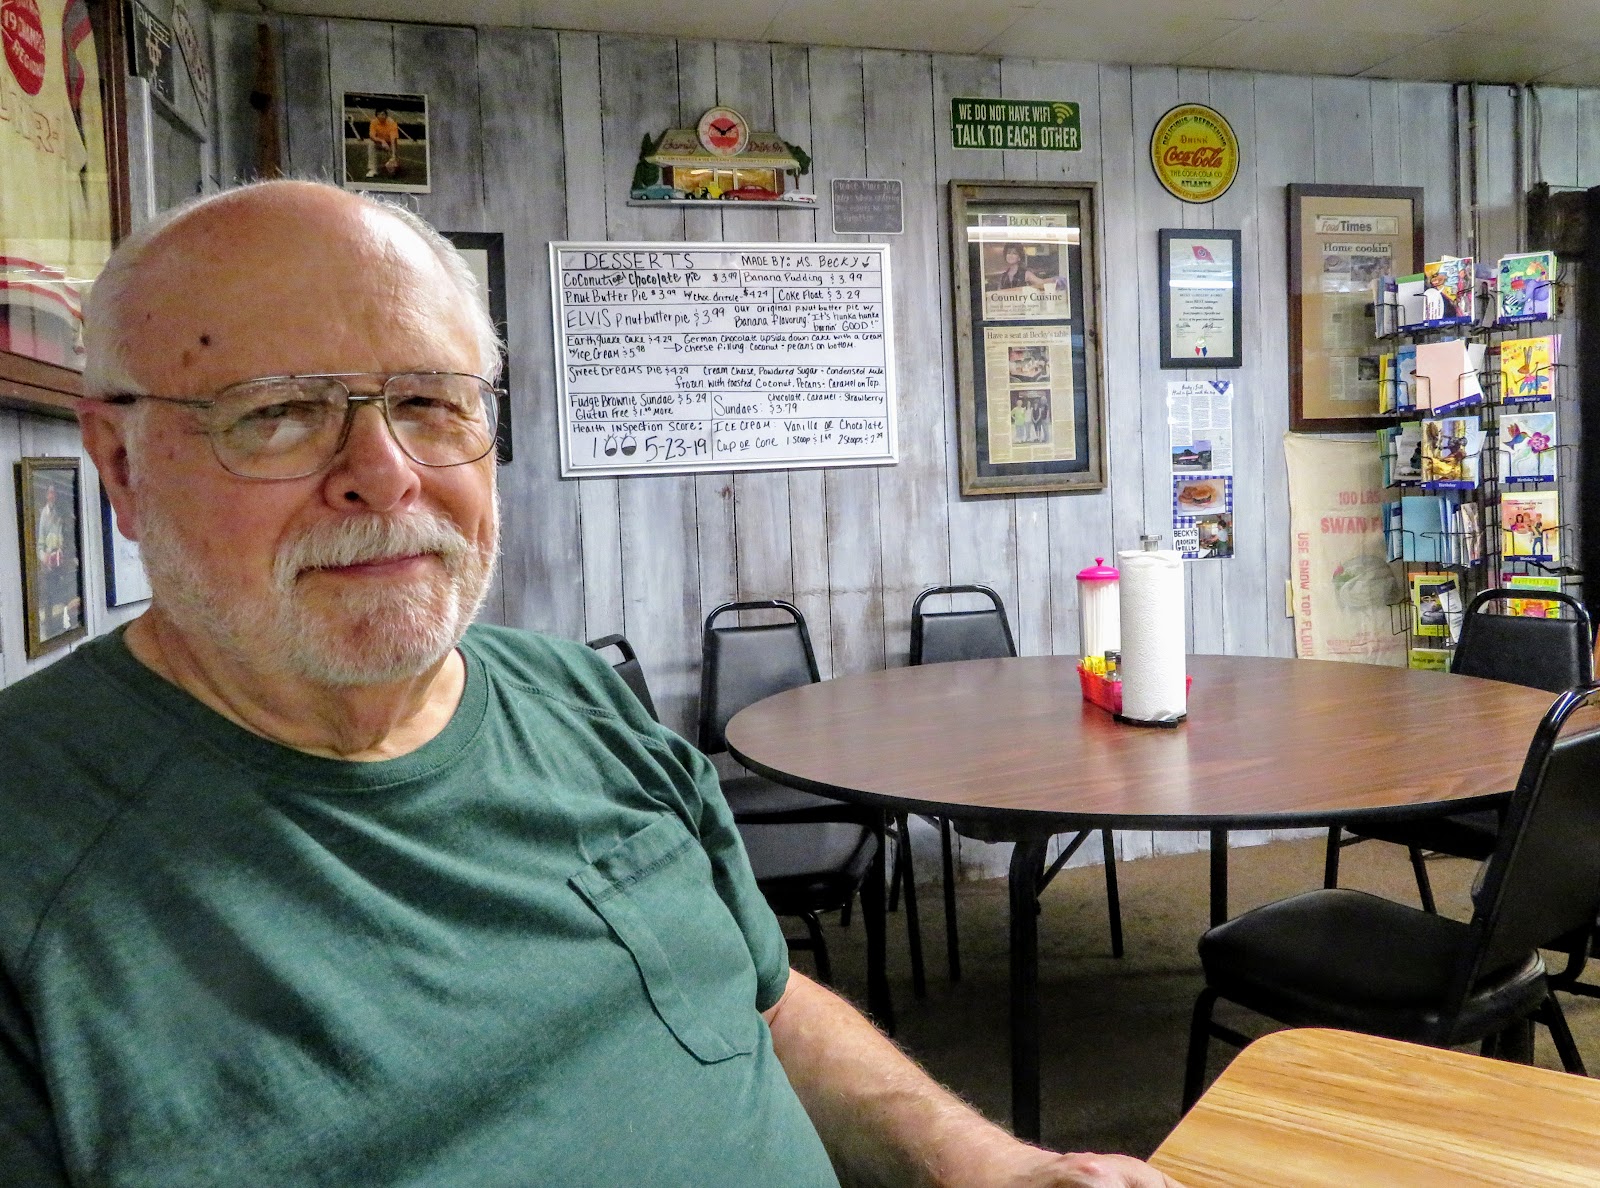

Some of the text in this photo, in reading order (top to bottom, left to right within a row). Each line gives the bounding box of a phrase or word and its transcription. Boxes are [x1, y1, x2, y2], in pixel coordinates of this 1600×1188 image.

[959, 104, 1051, 122] WE DO NOT HAVE WIFI
[957, 124, 1078, 148] TALK TO EACH OTHER
[1341, 220, 1372, 232] Times
[1324, 241, 1352, 252] Home
[584, 252, 695, 269] DESSERTS
[741, 255, 769, 267] MADE
[744, 272, 781, 284] Banana
[785, 273, 823, 286] Pudding
[592, 290, 628, 303] Butter
[632, 290, 648, 301] Pie
[991, 292, 1063, 304] Country Cuisine
[567, 309, 611, 328] ELVIS
[735, 315, 769, 328] Banana
[684, 333, 718, 344] German
[788, 333, 809, 342] down
[987, 332, 1004, 340] Have
[817, 343, 826, 351] on
[571, 396, 600, 411] Fudge
[602, 395, 638, 408] Brownie
[640, 394, 675, 407] Sundae
[612, 408, 630, 418] Free
[573, 423, 606, 434] Health
[784, 420, 819, 432] Vanilla
[717, 438, 737, 452] Cup
[756, 436, 779, 448] Cone
[1320, 516, 1367, 534] SWAN
[1297, 532, 1314, 657] USE SNOW TOP FLOUR
